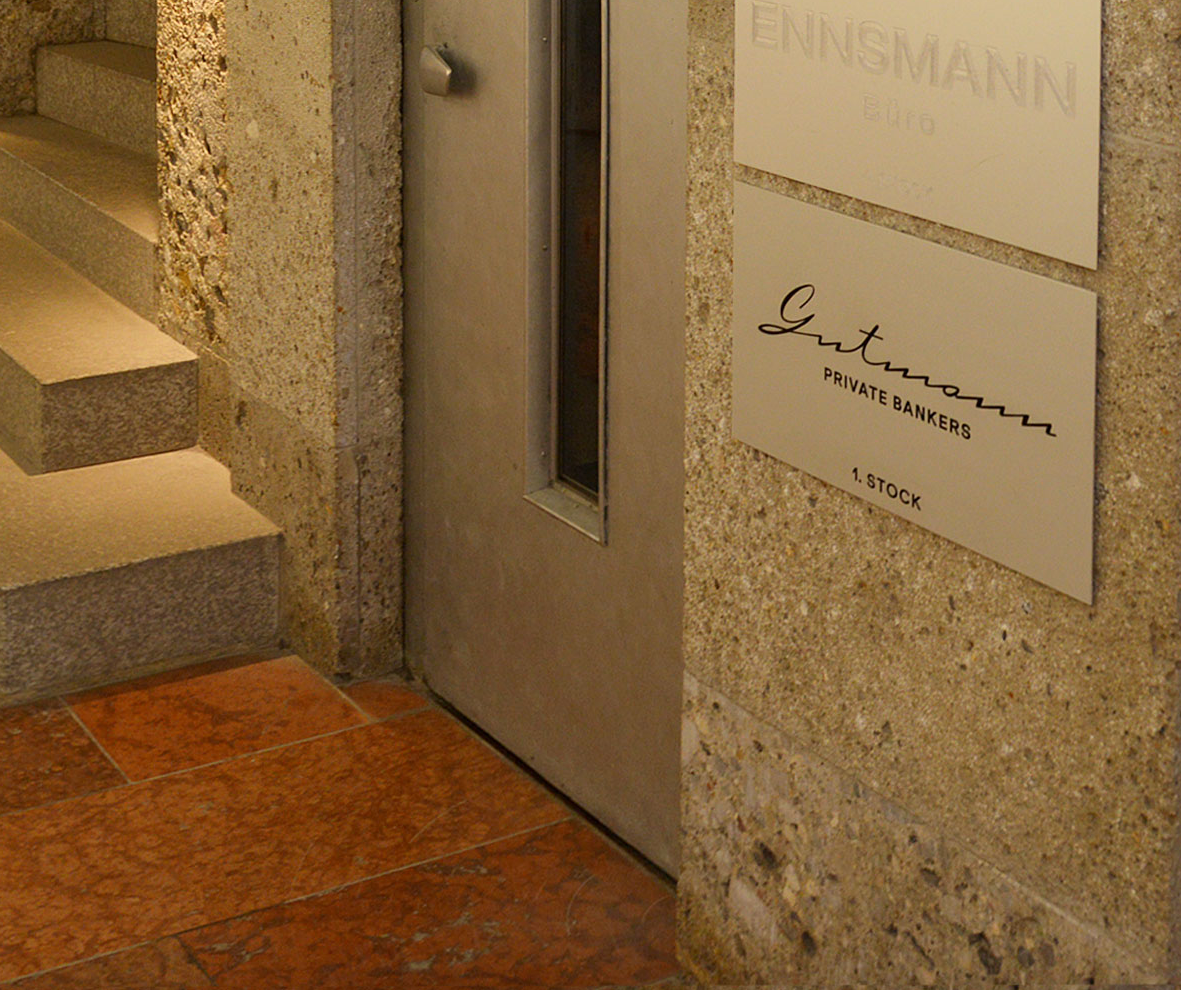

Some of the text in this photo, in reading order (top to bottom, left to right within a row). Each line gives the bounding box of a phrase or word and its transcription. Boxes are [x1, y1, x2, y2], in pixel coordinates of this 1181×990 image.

[863, 93, 936, 136] Büro
[758, 284, 1057, 438] Gutmann
[824, 366, 971, 440] PRIVATE BANKERS
[852, 467, 922, 511] 1. STOCK
